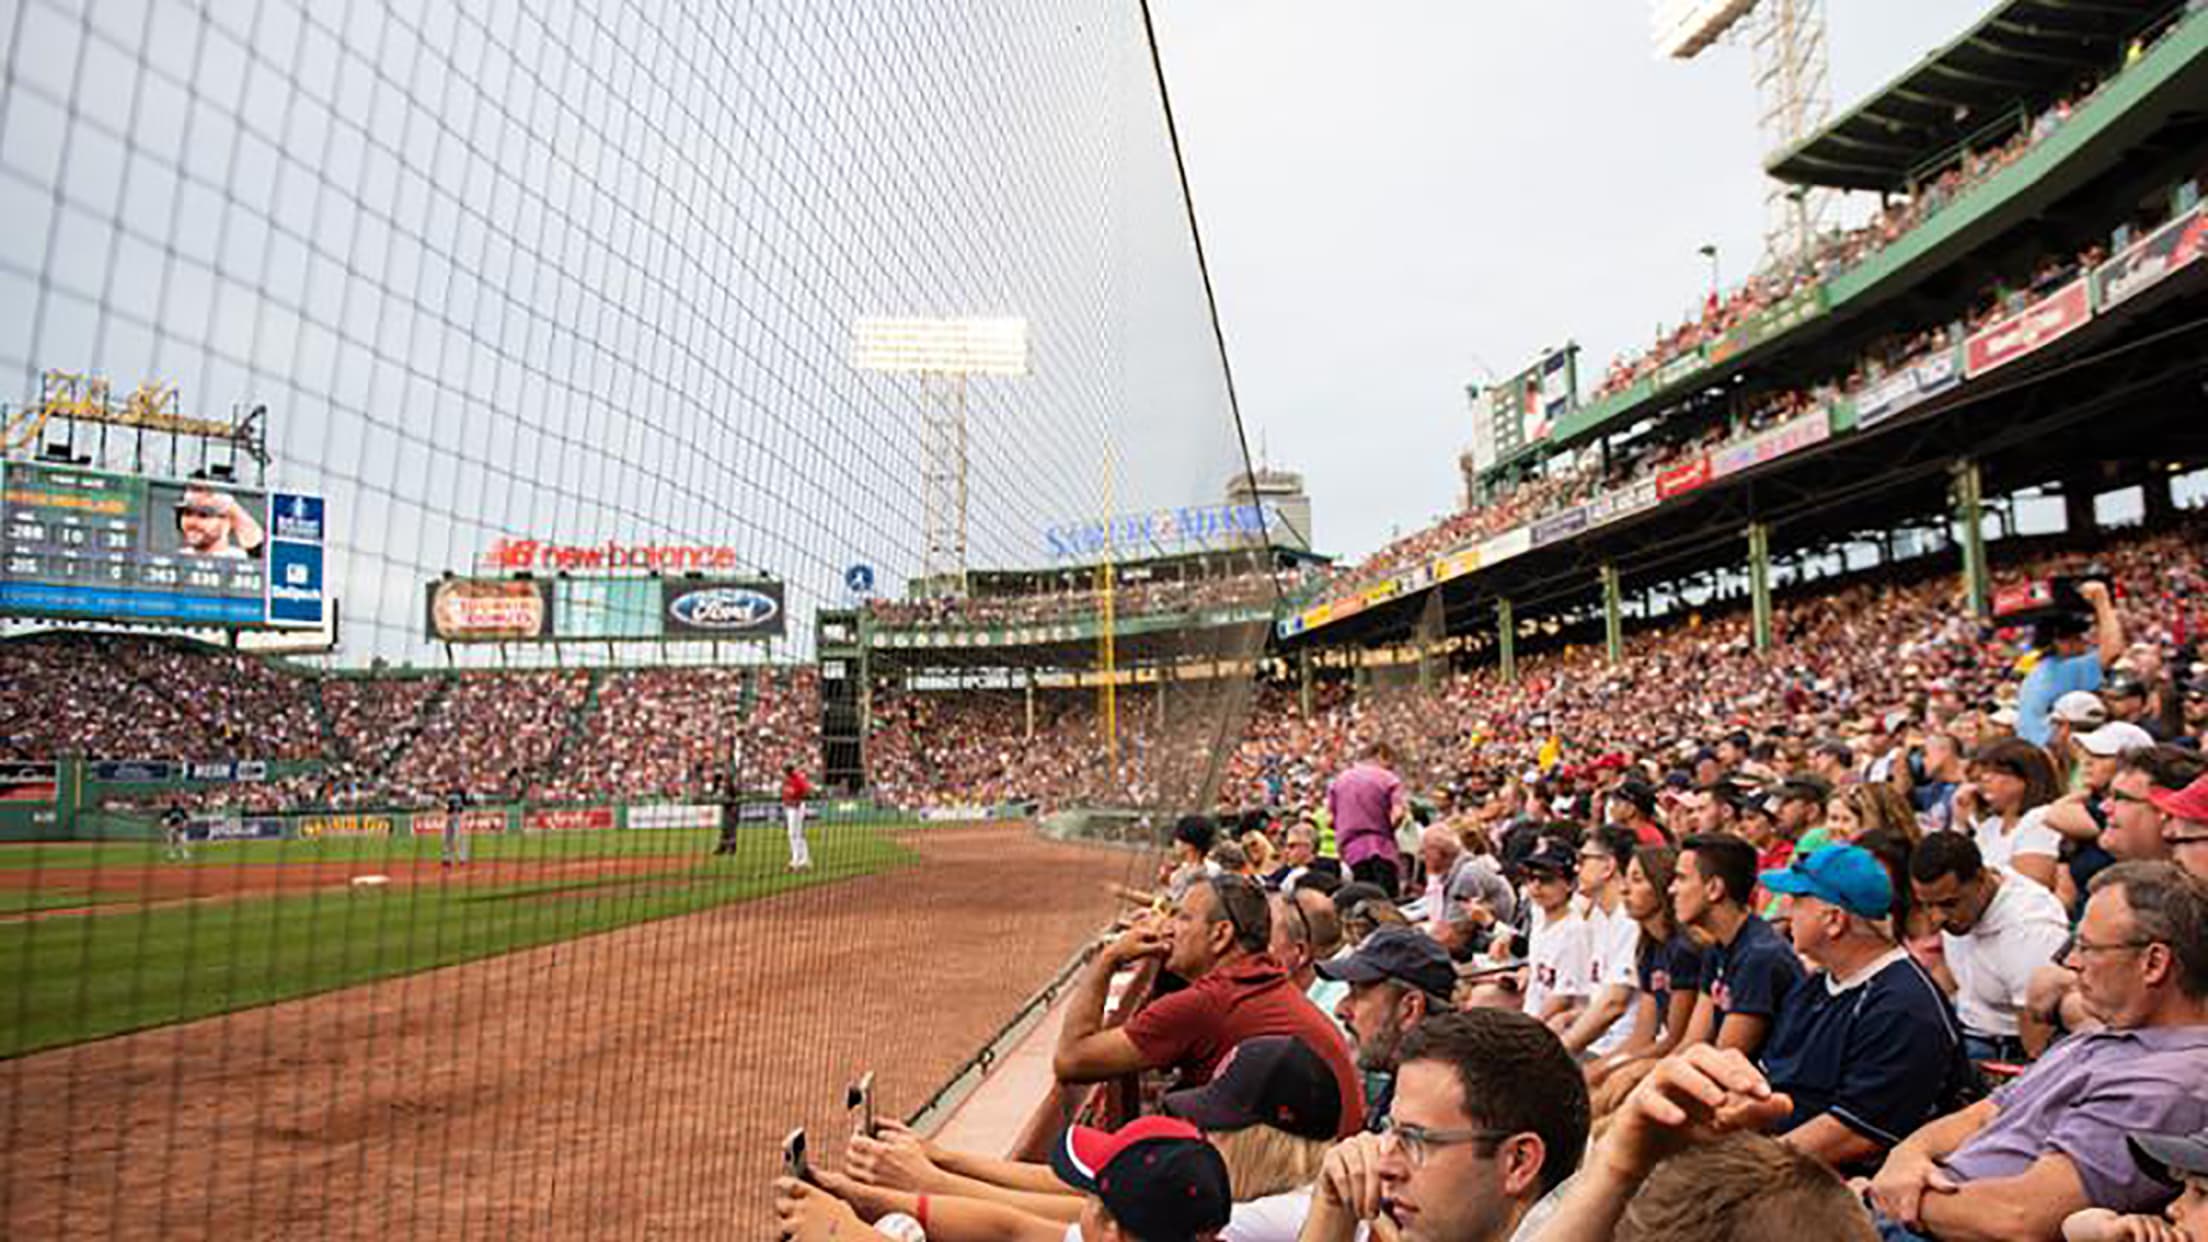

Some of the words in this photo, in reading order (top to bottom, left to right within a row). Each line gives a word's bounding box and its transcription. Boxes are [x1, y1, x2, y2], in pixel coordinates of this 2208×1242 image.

[541, 546, 602, 570] new
[607, 540, 737, 570] balance
[691, 599, 755, 621] Ford
